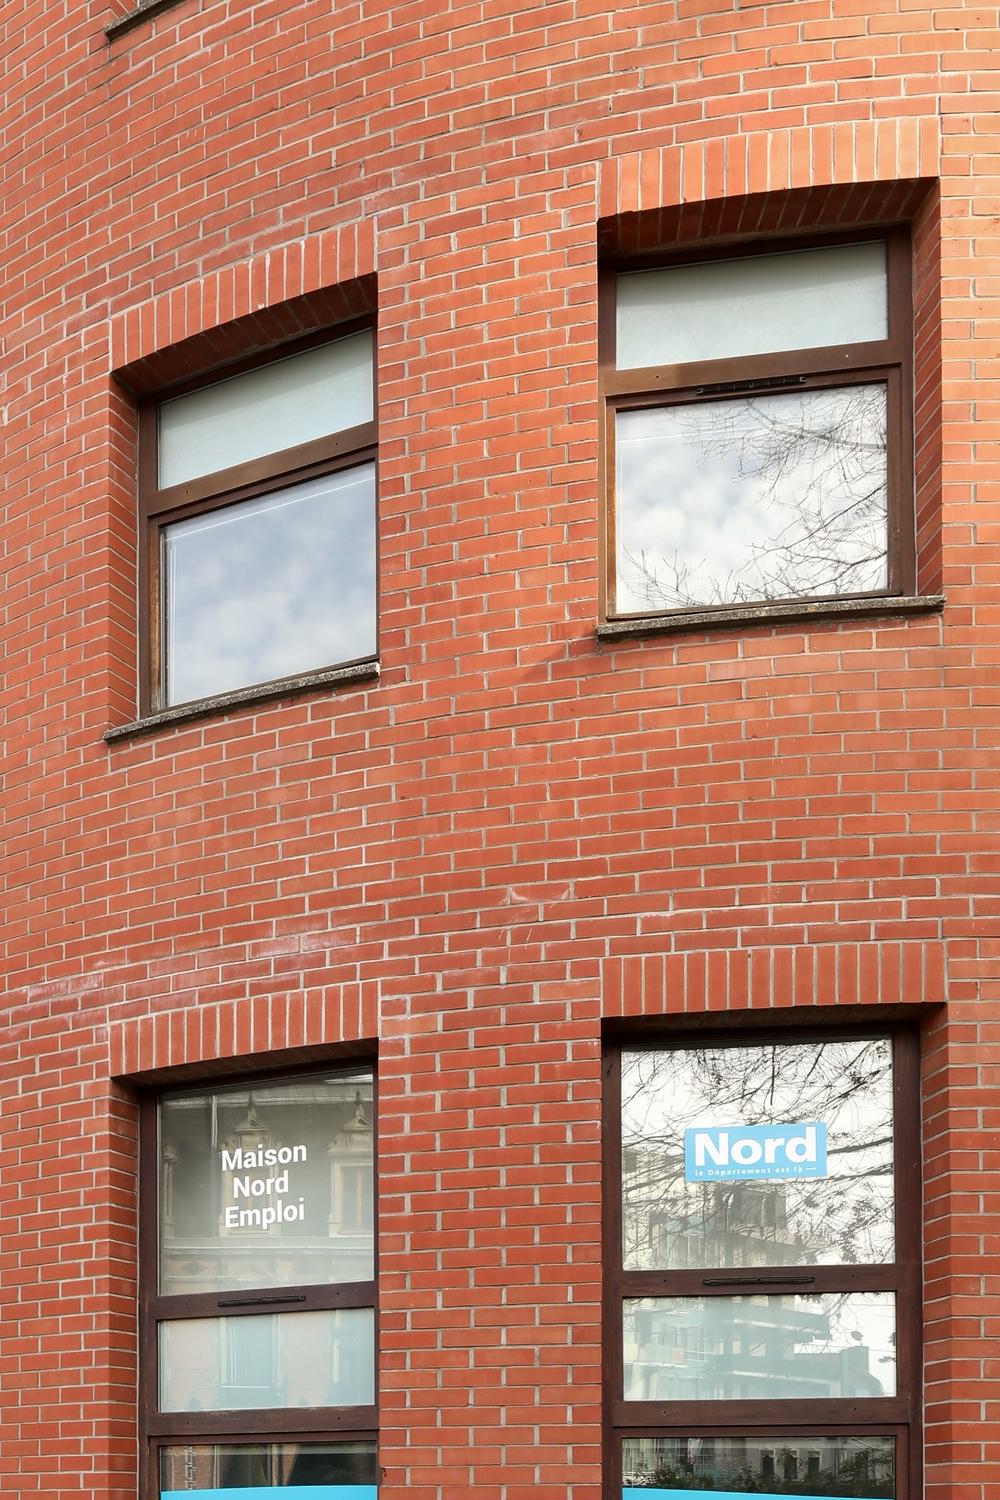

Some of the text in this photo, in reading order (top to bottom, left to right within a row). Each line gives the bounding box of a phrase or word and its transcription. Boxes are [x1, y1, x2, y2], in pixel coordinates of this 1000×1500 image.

[222, 1144, 307, 1171] Maison
[695, 1127, 817, 1167] Nord
[233, 1170, 289, 1198] Nord
[708, 1167, 771, 1177] Département
[225, 1197, 304, 1229] Emploi
